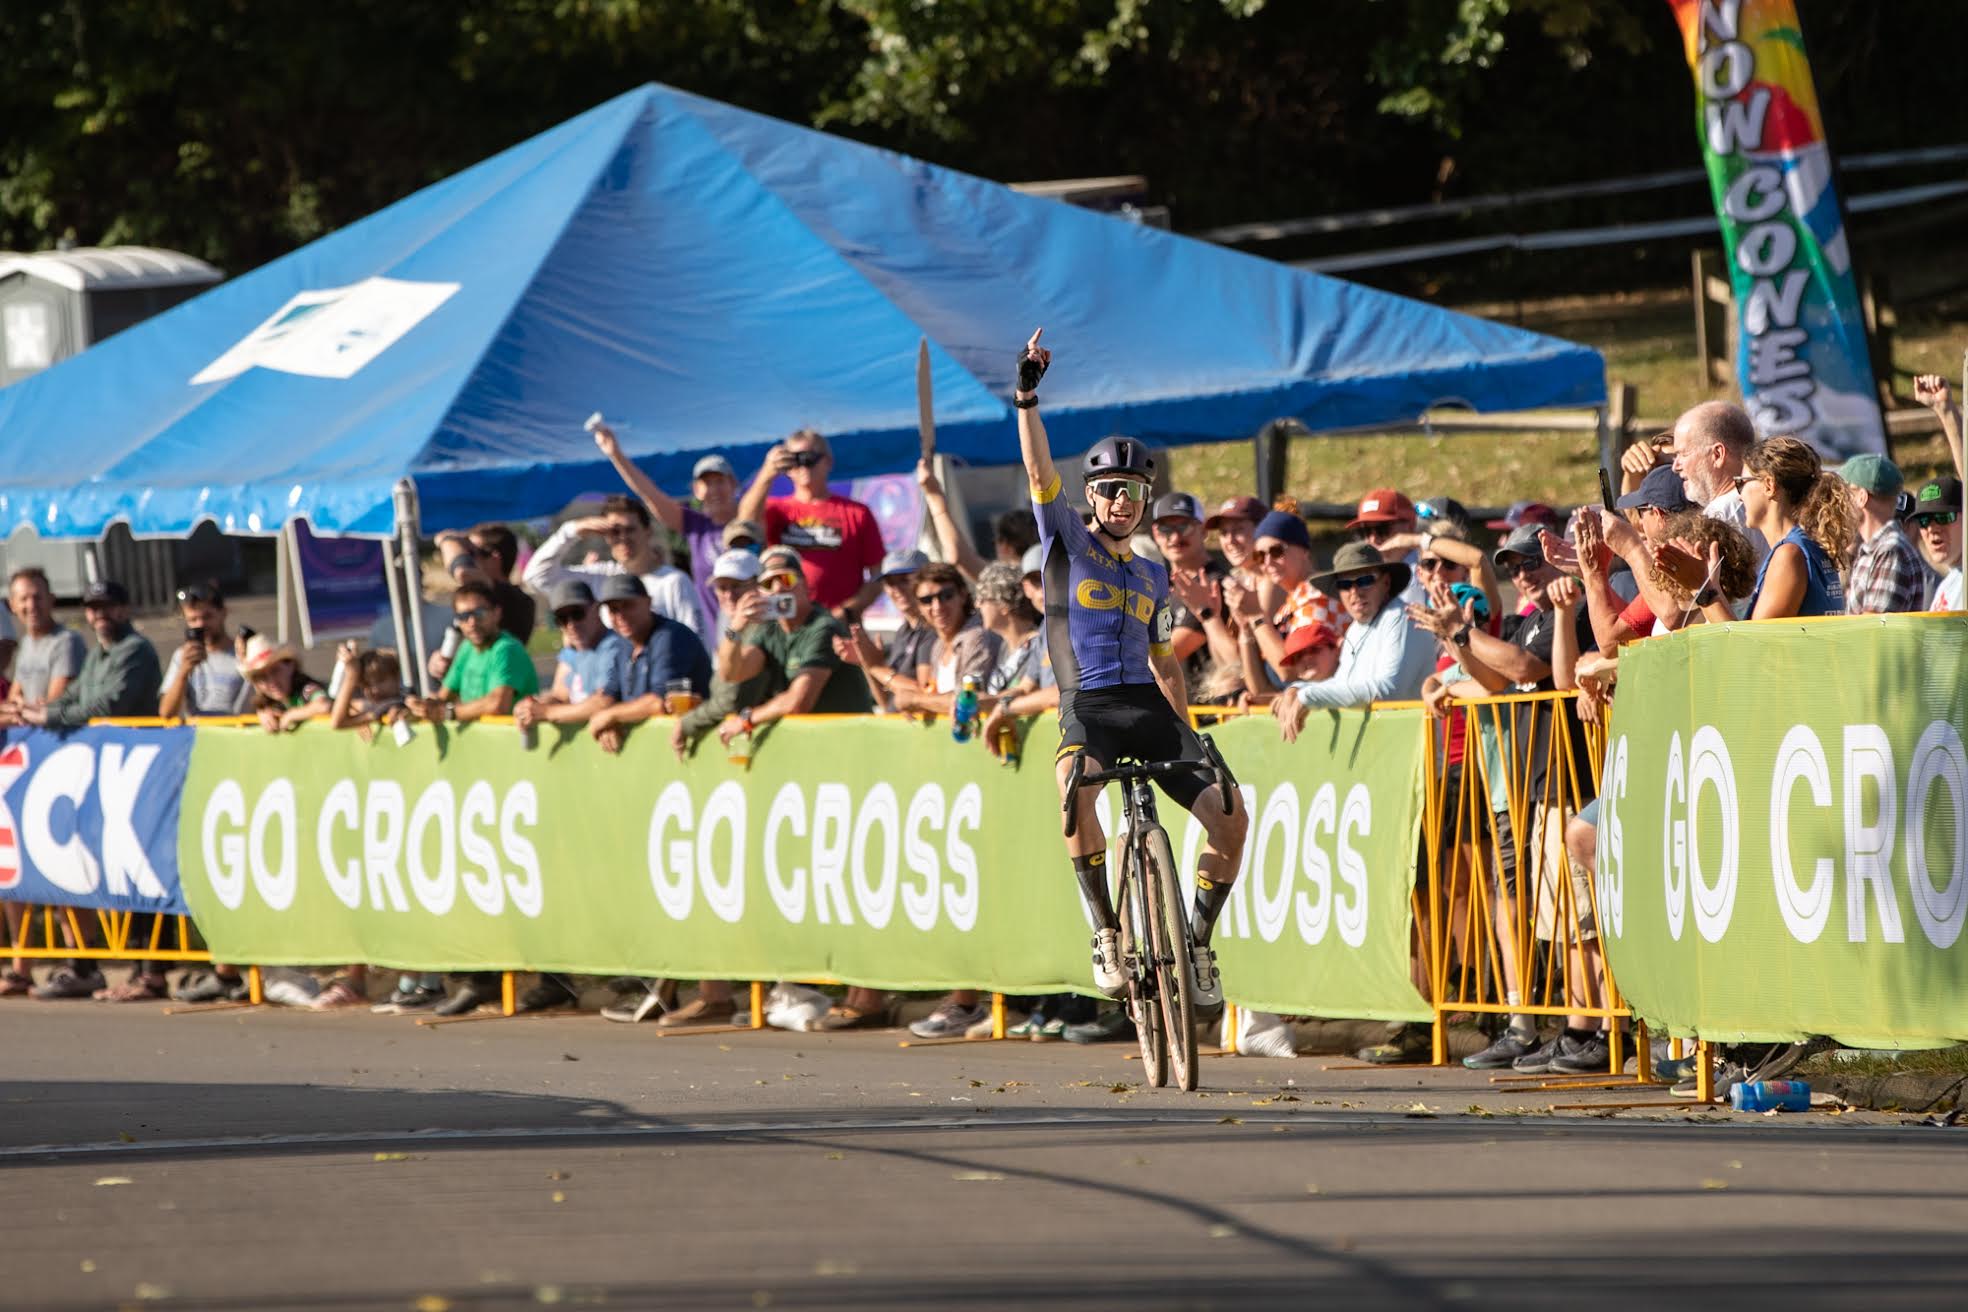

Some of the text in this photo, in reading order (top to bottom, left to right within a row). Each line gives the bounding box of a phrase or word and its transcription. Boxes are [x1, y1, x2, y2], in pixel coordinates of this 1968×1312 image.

[1725, 165, 1815, 432] CONES
[201, 776, 544, 919] GO CROSS
[647, 779, 748, 924] GO
[762, 780, 983, 933] CROSS
[1662, 725, 1740, 944] GO
